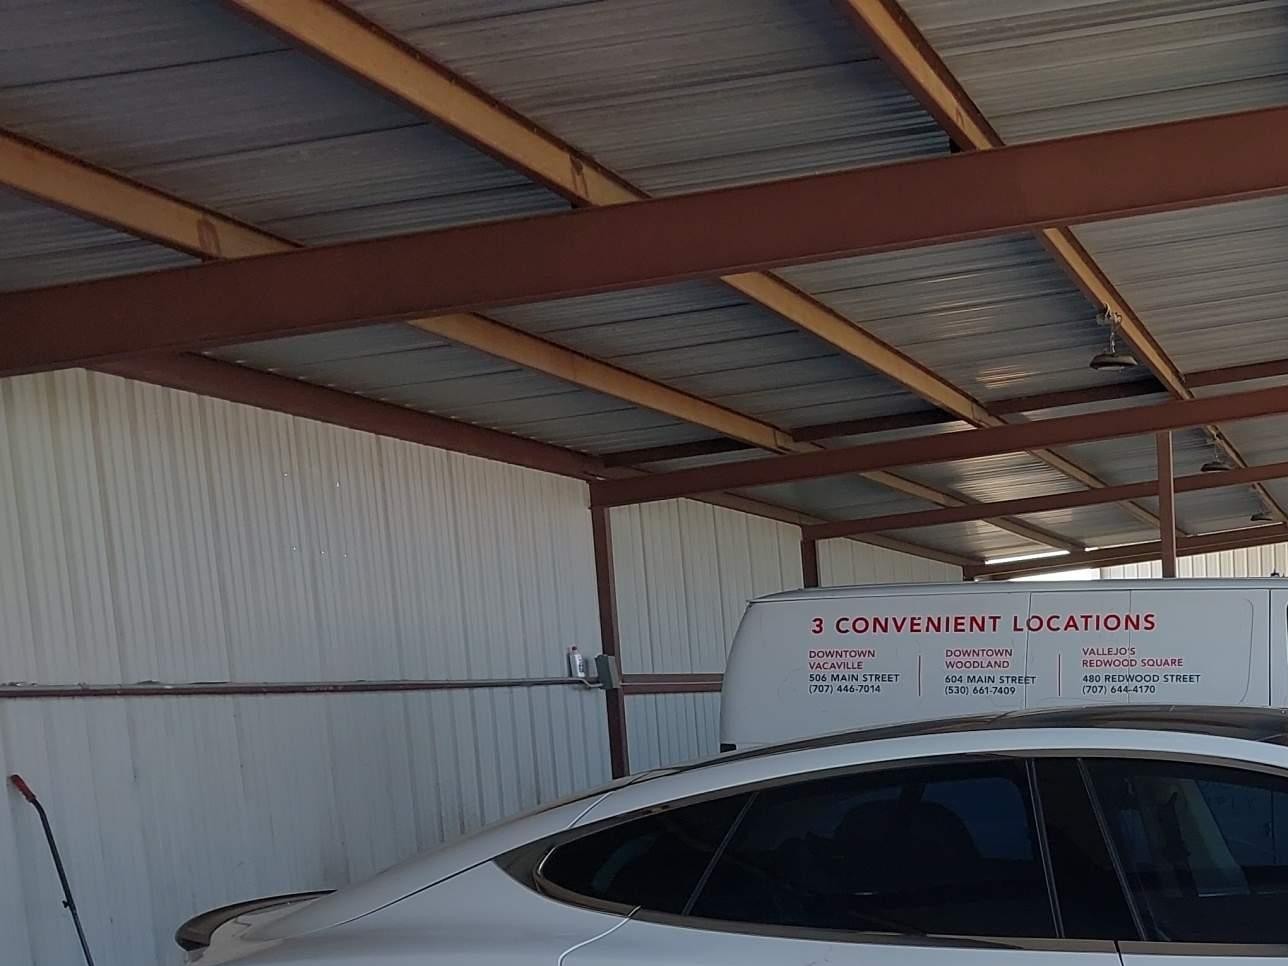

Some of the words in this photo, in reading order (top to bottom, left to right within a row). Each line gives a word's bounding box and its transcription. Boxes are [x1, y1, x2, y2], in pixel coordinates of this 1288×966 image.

[811, 617, 824, 634] 3
[835, 615, 1001, 634] CONVENIENT
[1012, 613, 1156, 632] LOCATIONS
[808, 649, 876, 659] DOWNTOWN
[945, 648, 1013, 658] DOWNTOWN
[1082, 647, 1136, 656] VALLEJO'S
[808, 661, 864, 671] VACAVILLE
[945, 660, 1010, 670] WOODLAND
[1082, 658, 1138, 668] REDWOOD
[1140, 658, 1184, 668] SQUARE
[808, 673, 827, 683] 506
[830, 673, 859, 683] MAIN
[862, 673, 900, 683] STREET
[944, 675, 963, 684] 604
[966, 675, 995, 685] MAIN
[999, 675, 1037, 685] STREET
[1082, 674, 1101, 683] 480
[1104, 674, 1160, 683] REDWOOD
[1163, 674, 1201, 683] STREET
[808, 684, 834, 695] (707)
[836, 684, 881, 693] 446-7014
[944, 686, 969, 696] (530)
[972, 686, 1016, 695] 661-7409
[1082, 685, 1107, 695] (707)
[1110, 685, 1156, 694] 644-4170
